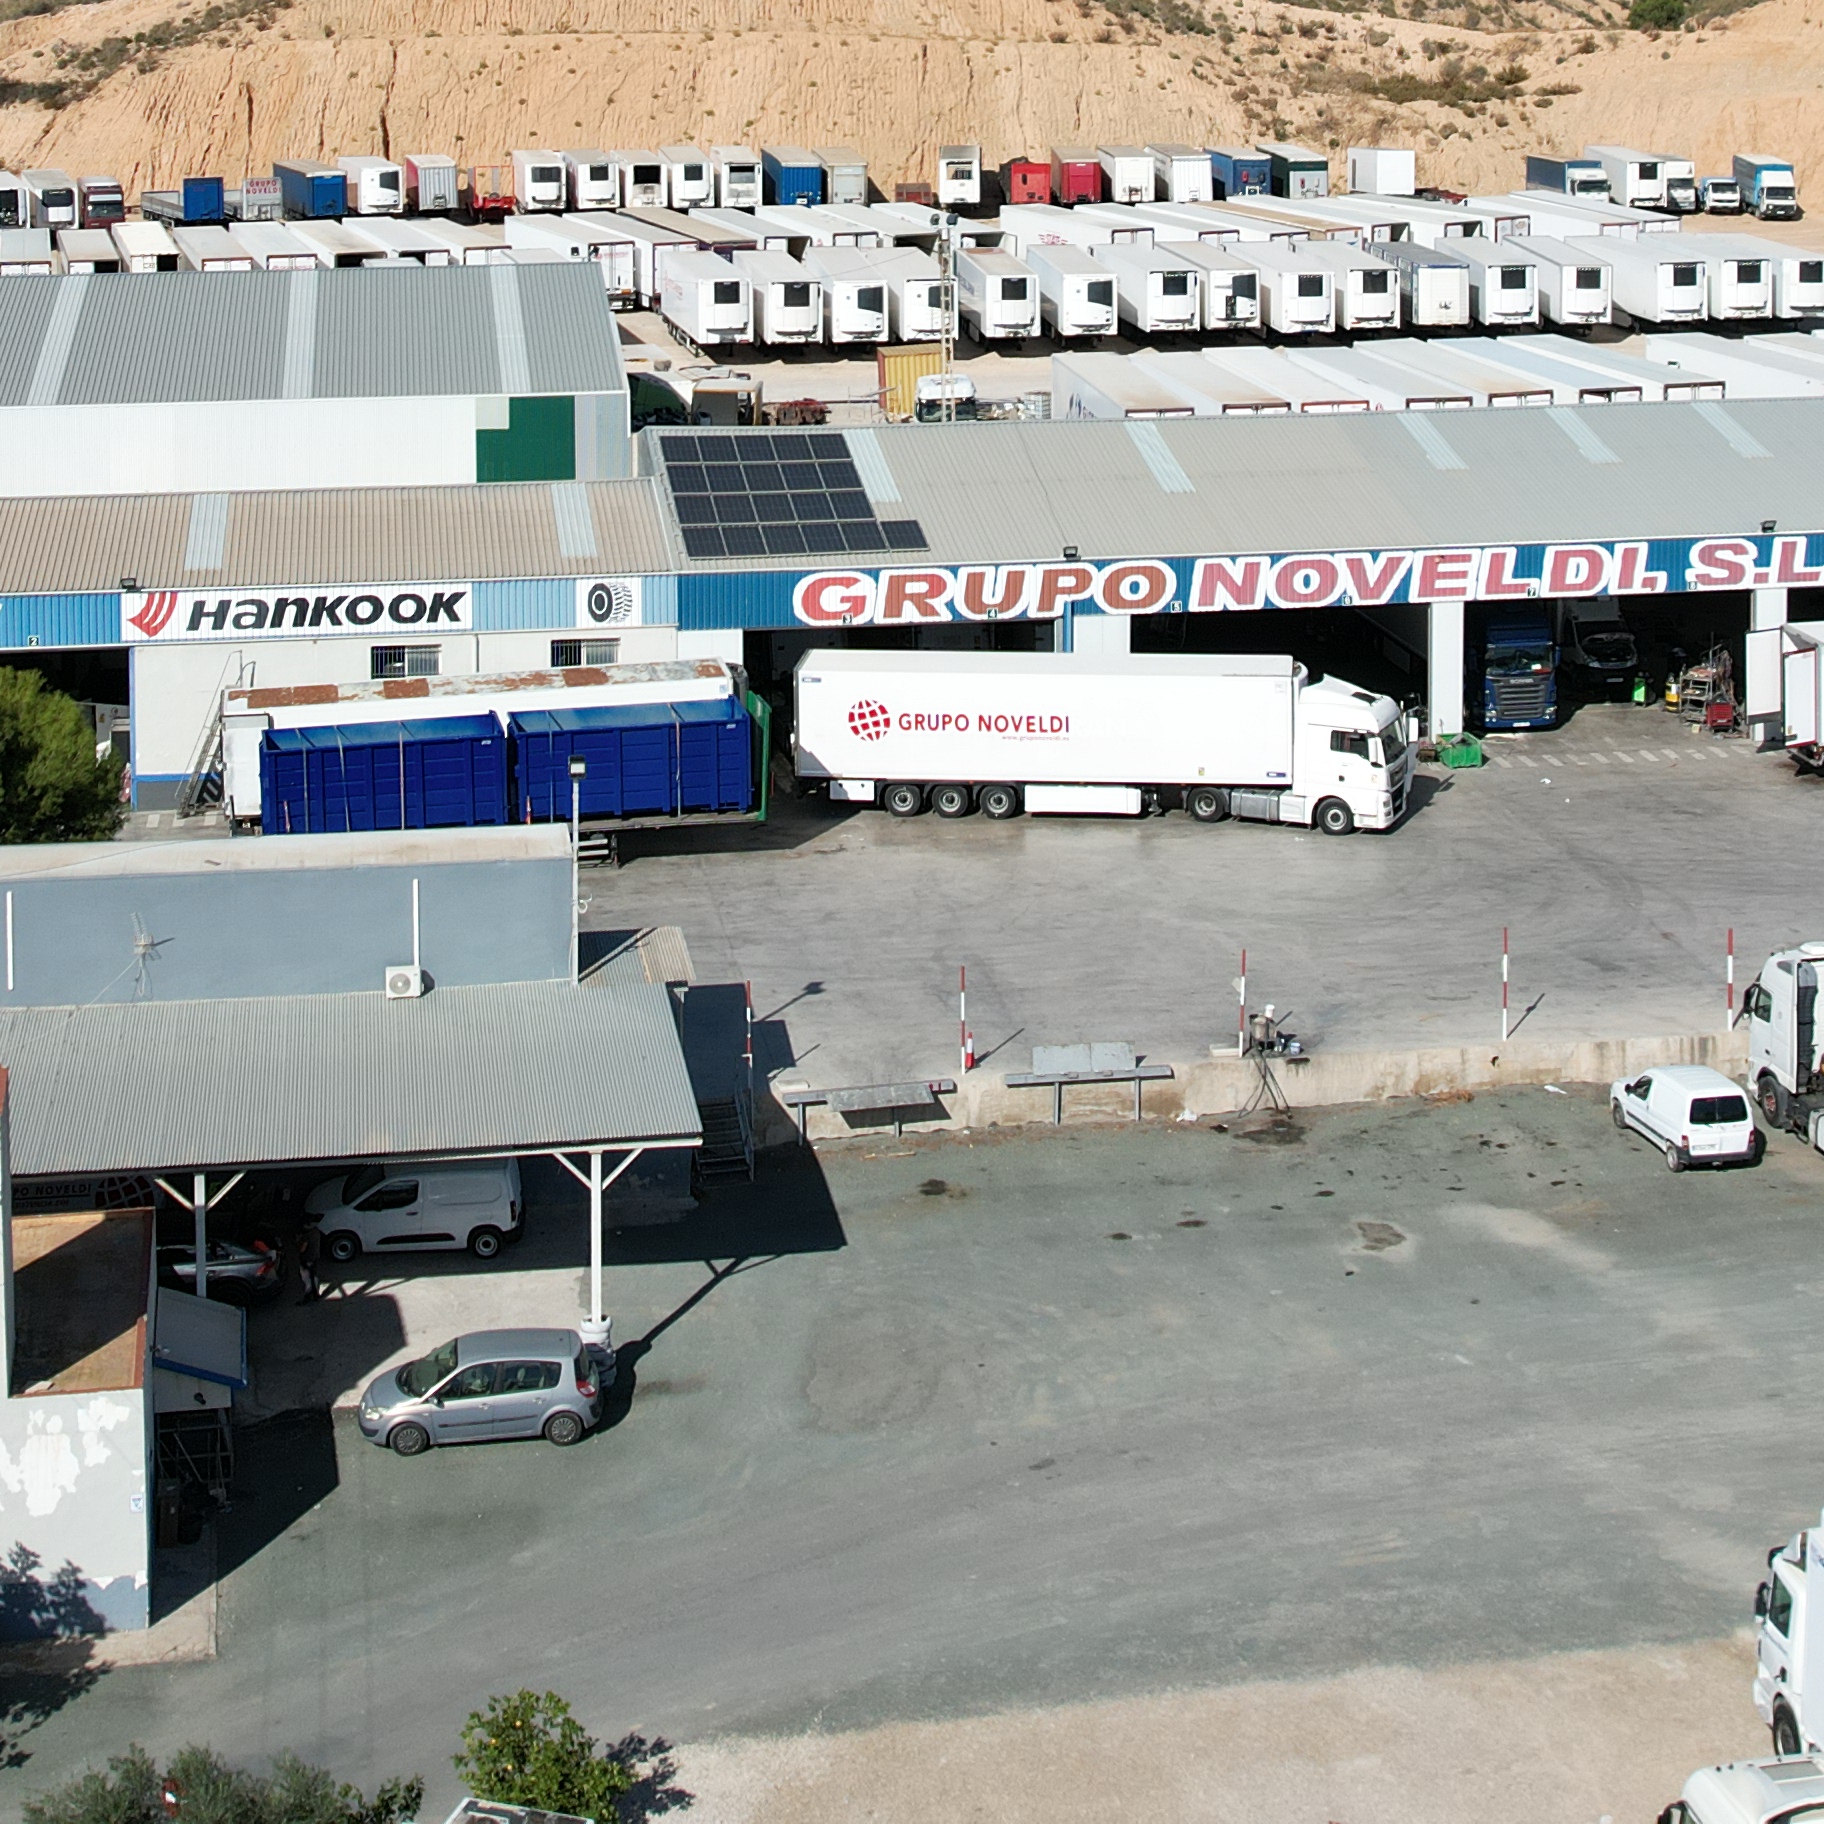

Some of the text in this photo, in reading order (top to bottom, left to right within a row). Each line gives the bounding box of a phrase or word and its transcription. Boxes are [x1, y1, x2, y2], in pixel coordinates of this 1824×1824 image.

[794, 561, 1175, 625] GRUPO
[898, 713, 1069, 733] GRUPO NOVELDI
[35, 1184, 92, 1196] NOVELDI
